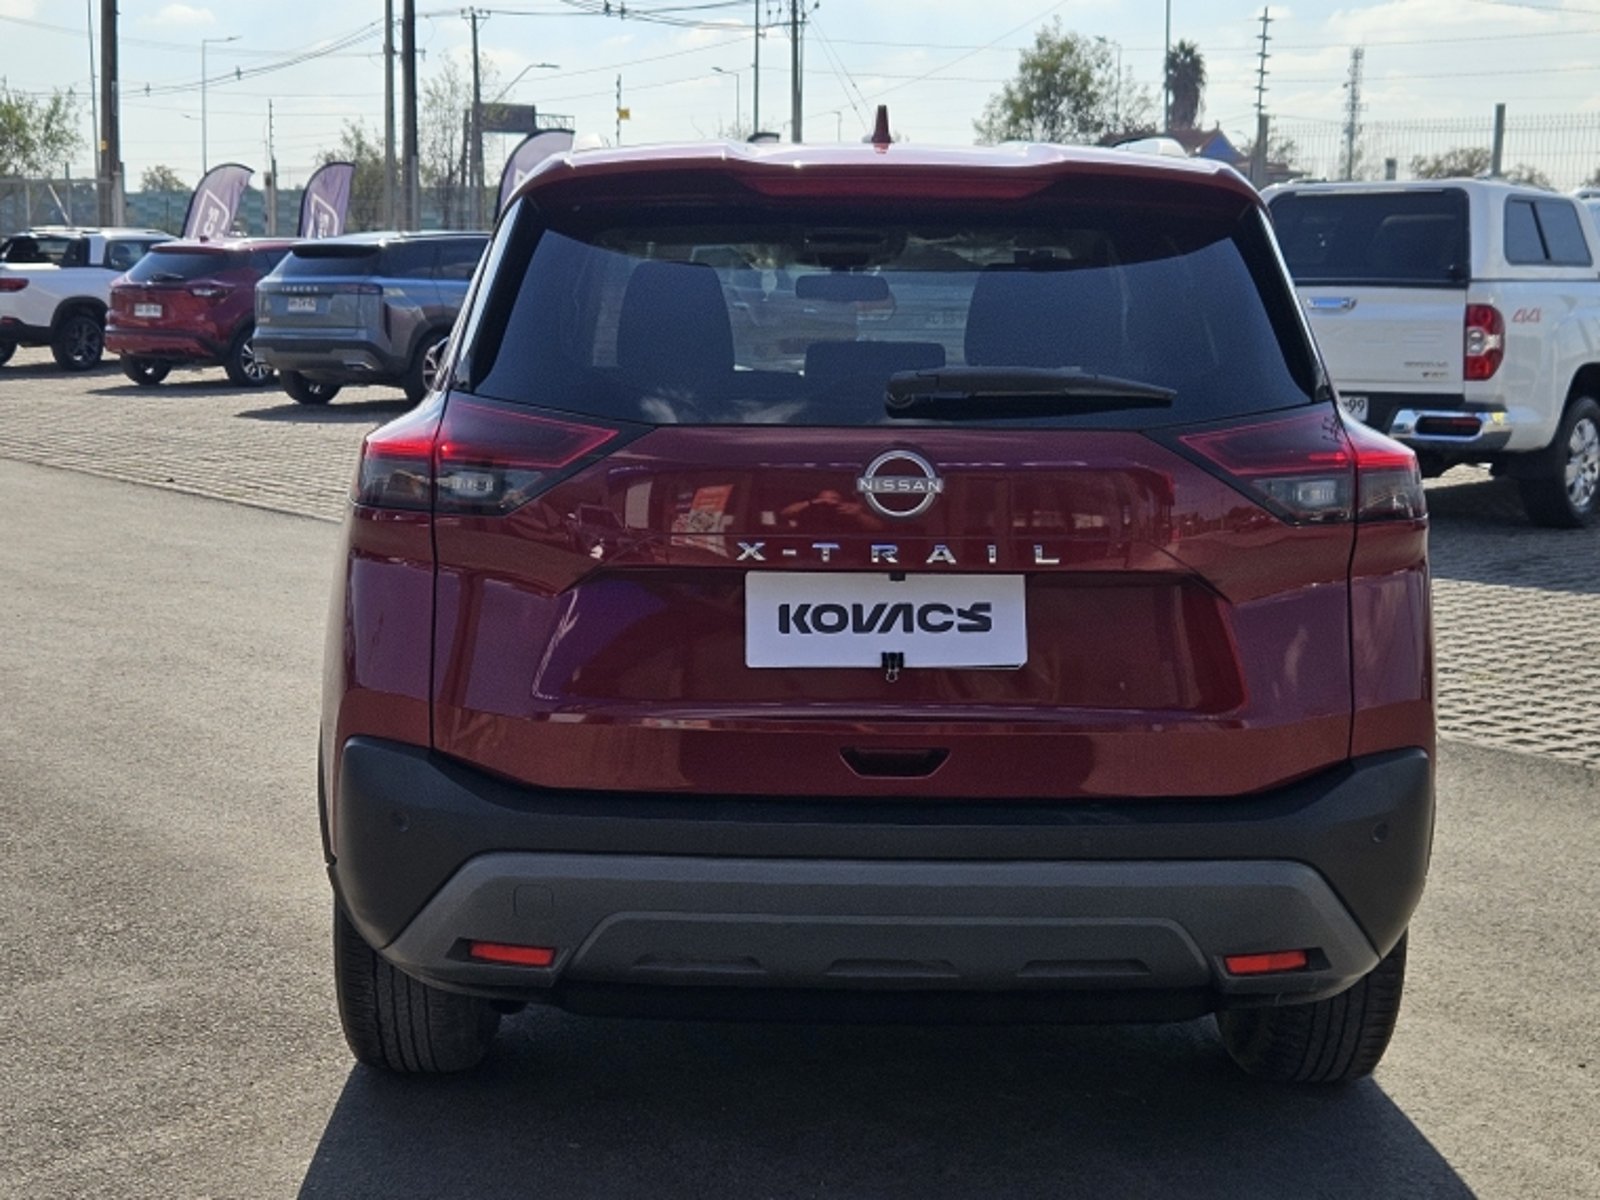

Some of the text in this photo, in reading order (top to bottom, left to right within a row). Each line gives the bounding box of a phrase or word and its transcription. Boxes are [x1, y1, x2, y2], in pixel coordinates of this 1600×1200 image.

[859, 479, 942, 492] NISSAN
[736, 542, 1060, 564] X-TRAIL
[778, 602, 992, 634] KOVACS
